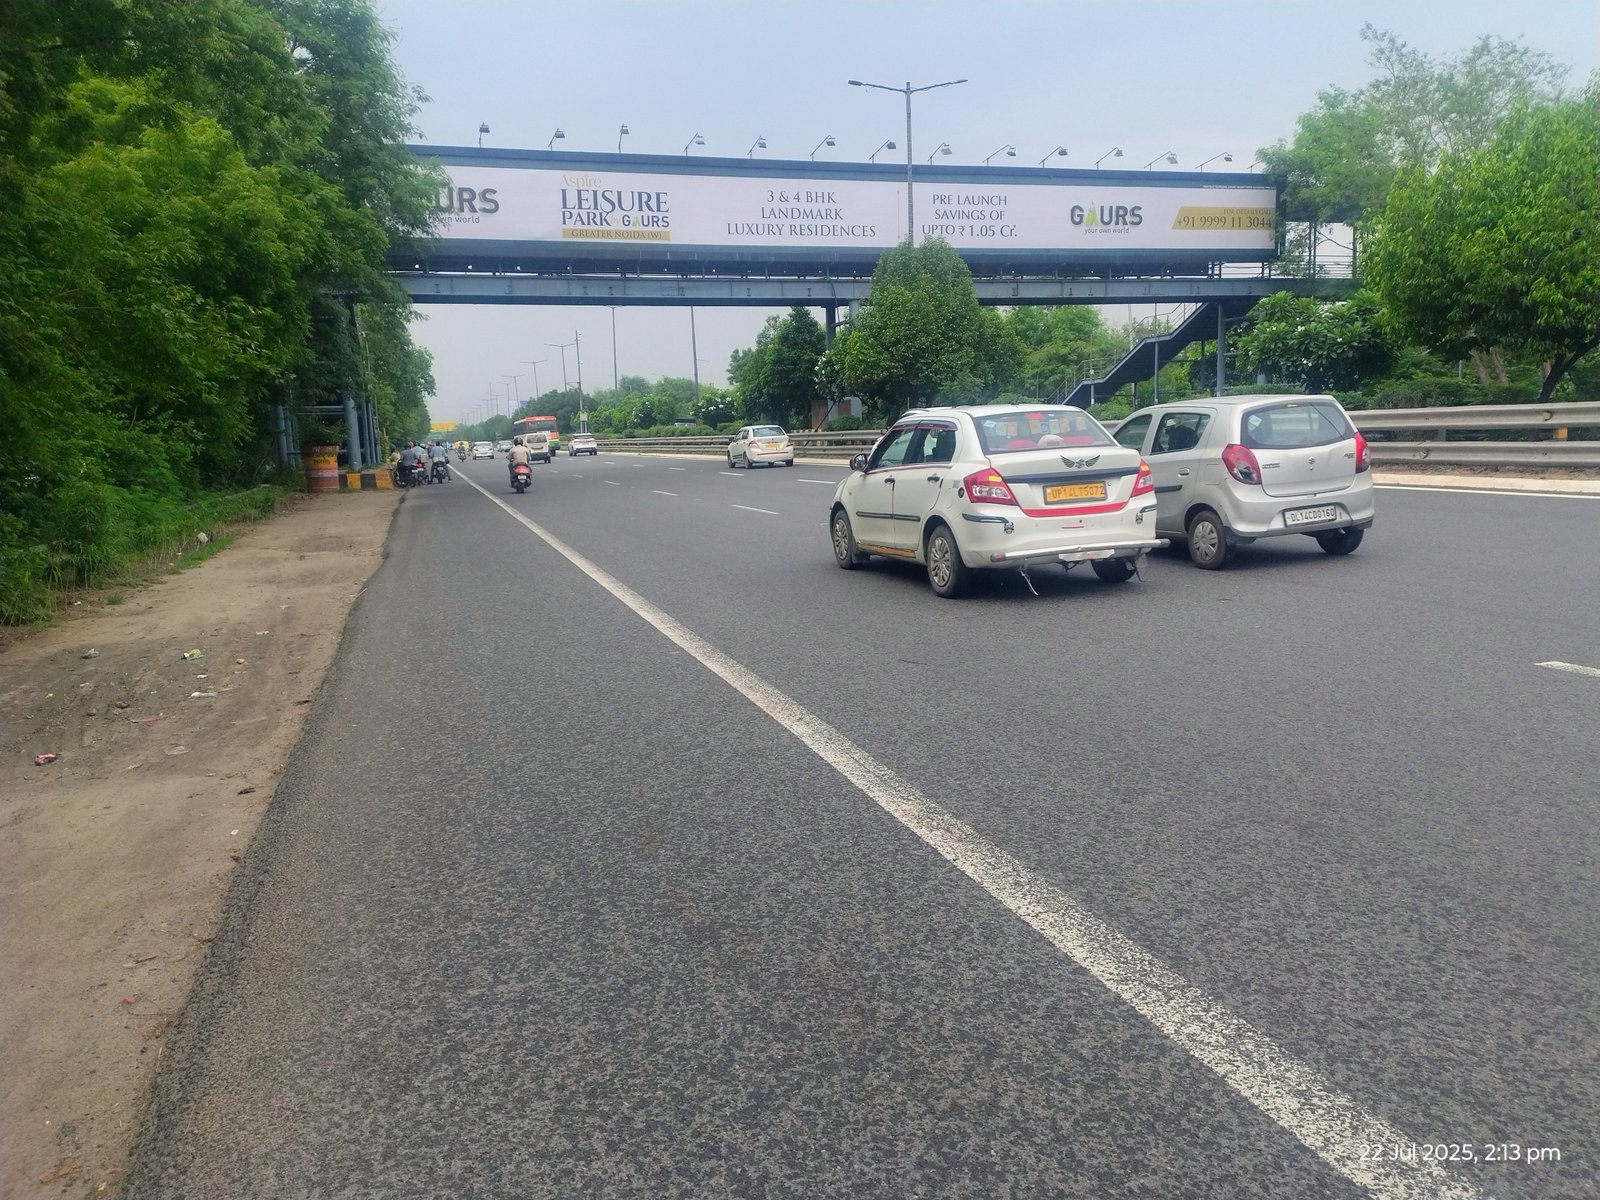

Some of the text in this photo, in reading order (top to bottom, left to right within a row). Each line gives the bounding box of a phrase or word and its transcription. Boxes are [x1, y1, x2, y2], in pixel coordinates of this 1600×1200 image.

[560, 174, 602, 188] Aspire
[560, 188, 670, 214] LEISURE
[767, 190, 837, 204] 3 & 4 BHK
[932, 194, 1007, 206] PRE LAUNCH
[455, 216, 480, 224] world
[562, 210, 612, 226] PARK
[622, 214, 670, 228] GAURS
[761, 206, 844, 220] LANDMARK
[934, 209, 1006, 220] SAVINGS OF
[1070, 200, 1143, 226] GAURS
[1177, 216, 1272, 228] +91 9999 11 3044
[572, 228, 662, 240] GREATER NOIDA (W)
[726, 222, 876, 237] LUXURY RESIDENCES
[922, 224, 956, 235] UPTO
